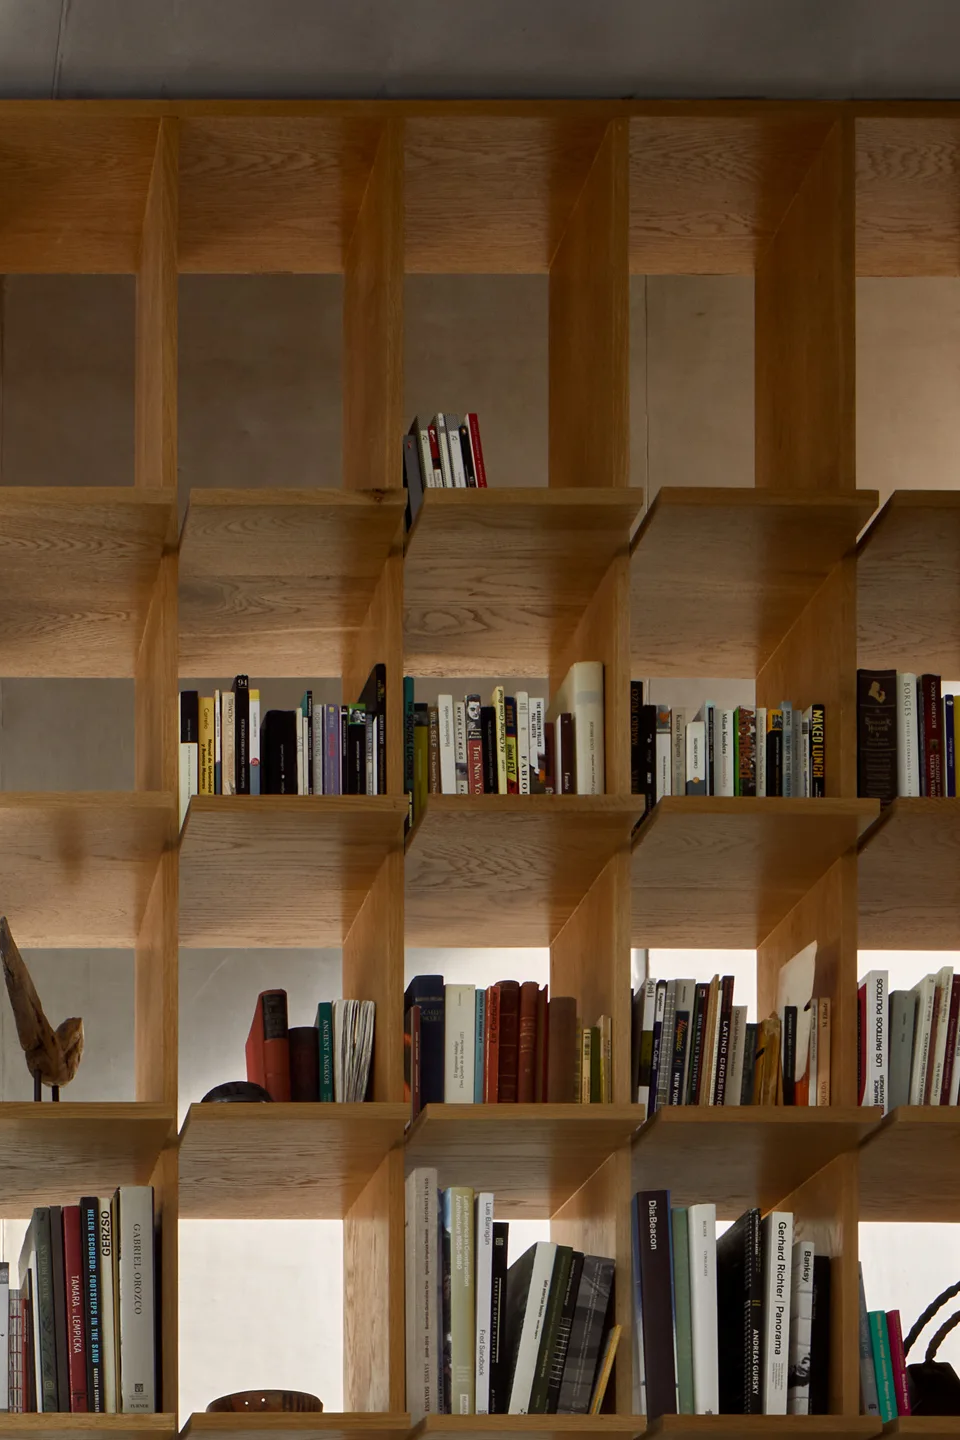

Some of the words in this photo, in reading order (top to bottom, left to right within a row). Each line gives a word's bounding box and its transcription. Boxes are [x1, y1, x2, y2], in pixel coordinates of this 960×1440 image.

[812, 710, 823, 742] NAKED
[813, 745, 823, 777] LUNCH
[322, 1019, 330, 1051] ANCIENT
[101, 1211, 110, 1256] GERZSO
[483, 1217, 491, 1245] Barragán
[648, 1200, 658, 1250] Dia:Beacon
[777, 1222, 786, 1261] Gerhard
[88, 1234, 96, 1272] ESCOBEDO:
[133, 1224, 141, 1270] GABRIEL
[776, 1264, 786, 1298] Richter
[802, 1251, 811, 1282] Banksy
[133, 1272, 142, 1315] OROZCO
[774, 1306, 784, 1355] Panorama
